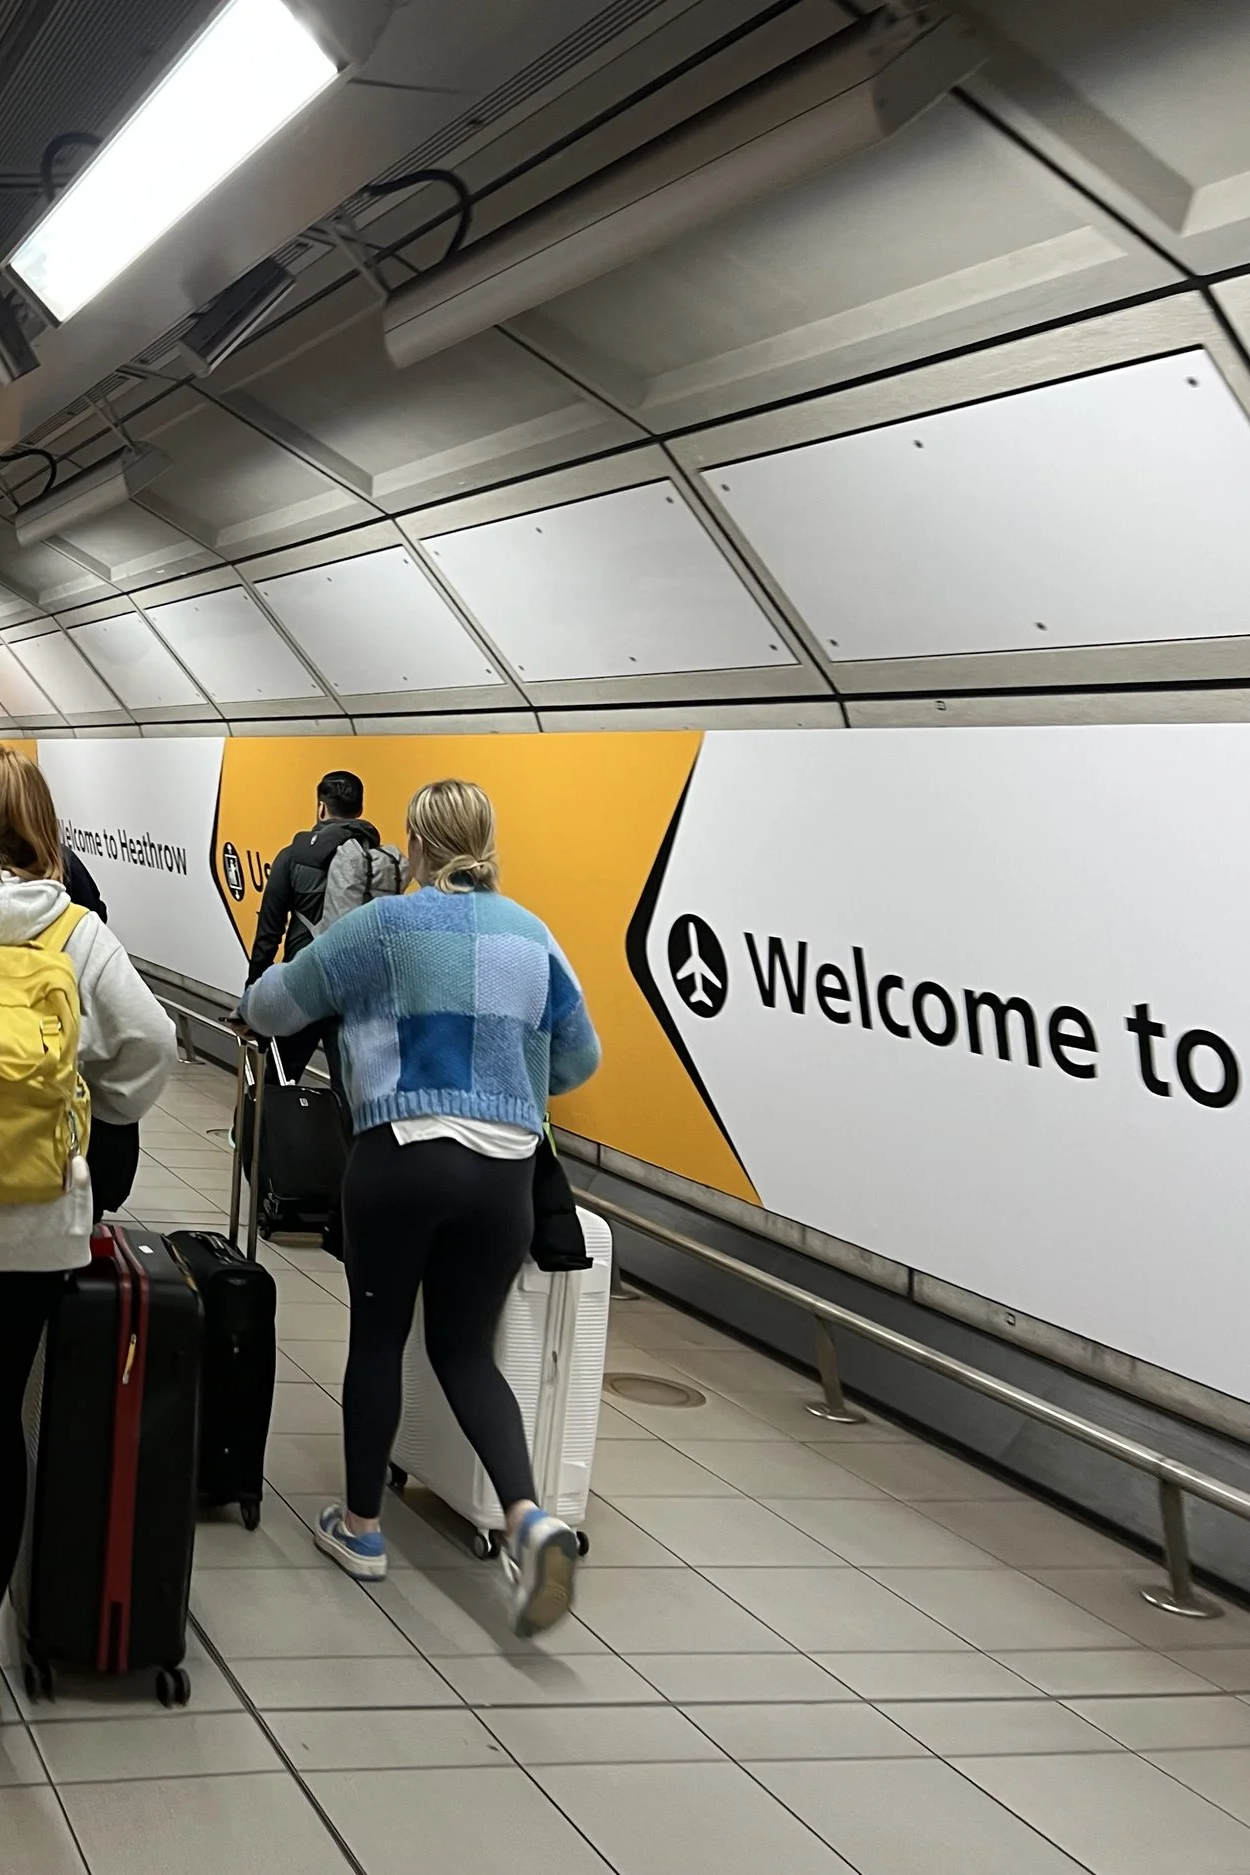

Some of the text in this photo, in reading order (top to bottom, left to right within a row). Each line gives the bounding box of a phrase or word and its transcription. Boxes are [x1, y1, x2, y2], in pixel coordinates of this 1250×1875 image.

[103, 828, 118, 860] to
[117, 828, 187, 876] Heathrow
[743, 931, 1241, 1109] Welcome to
